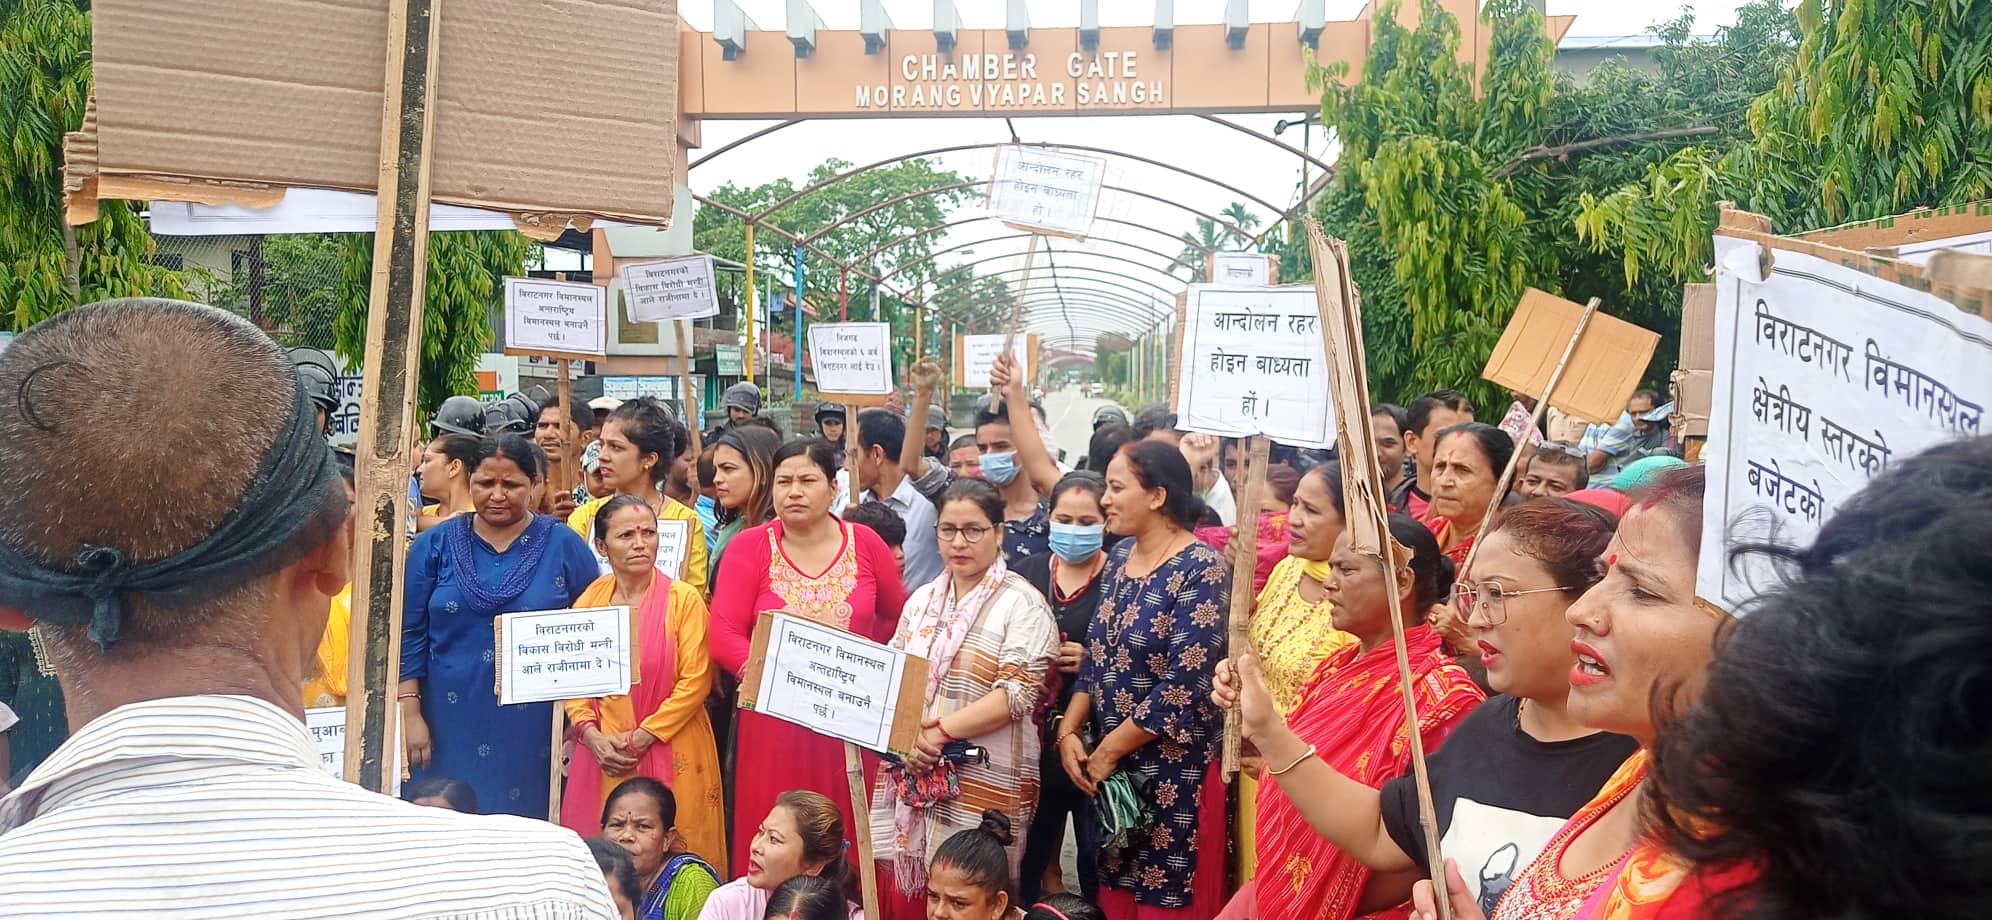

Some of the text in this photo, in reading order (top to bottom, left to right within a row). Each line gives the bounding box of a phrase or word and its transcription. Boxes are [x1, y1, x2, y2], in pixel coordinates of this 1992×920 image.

[902, 51, 1137, 81] CHAMBER GATE
[855, 80, 1163, 107] MORANG VYAPAR SANGH
[1213, 306, 1318, 335] आन्दोलन रहर
[1754, 298, 1853, 383] विराटनगर
[1210, 346, 1312, 378] होइन बाध्यता
[1752, 375, 1892, 480] क्षेत्रीय स्तरको
[1747, 457, 1825, 527] बजेटको
[535, 619, 595, 636] विराटनगरको
[518, 637, 613, 657] विकास विरोधी मन्त्री
[787, 630, 886, 672] विराटनगर विमानस्थल
[521, 662, 542, 675] आले
[547, 659, 592, 673] राजीनामा
[595, 656, 602, 669] दे
[786, 671, 872, 710] विमानस्थल बनाउनै
[813, 702, 829, 719] पर्छ
